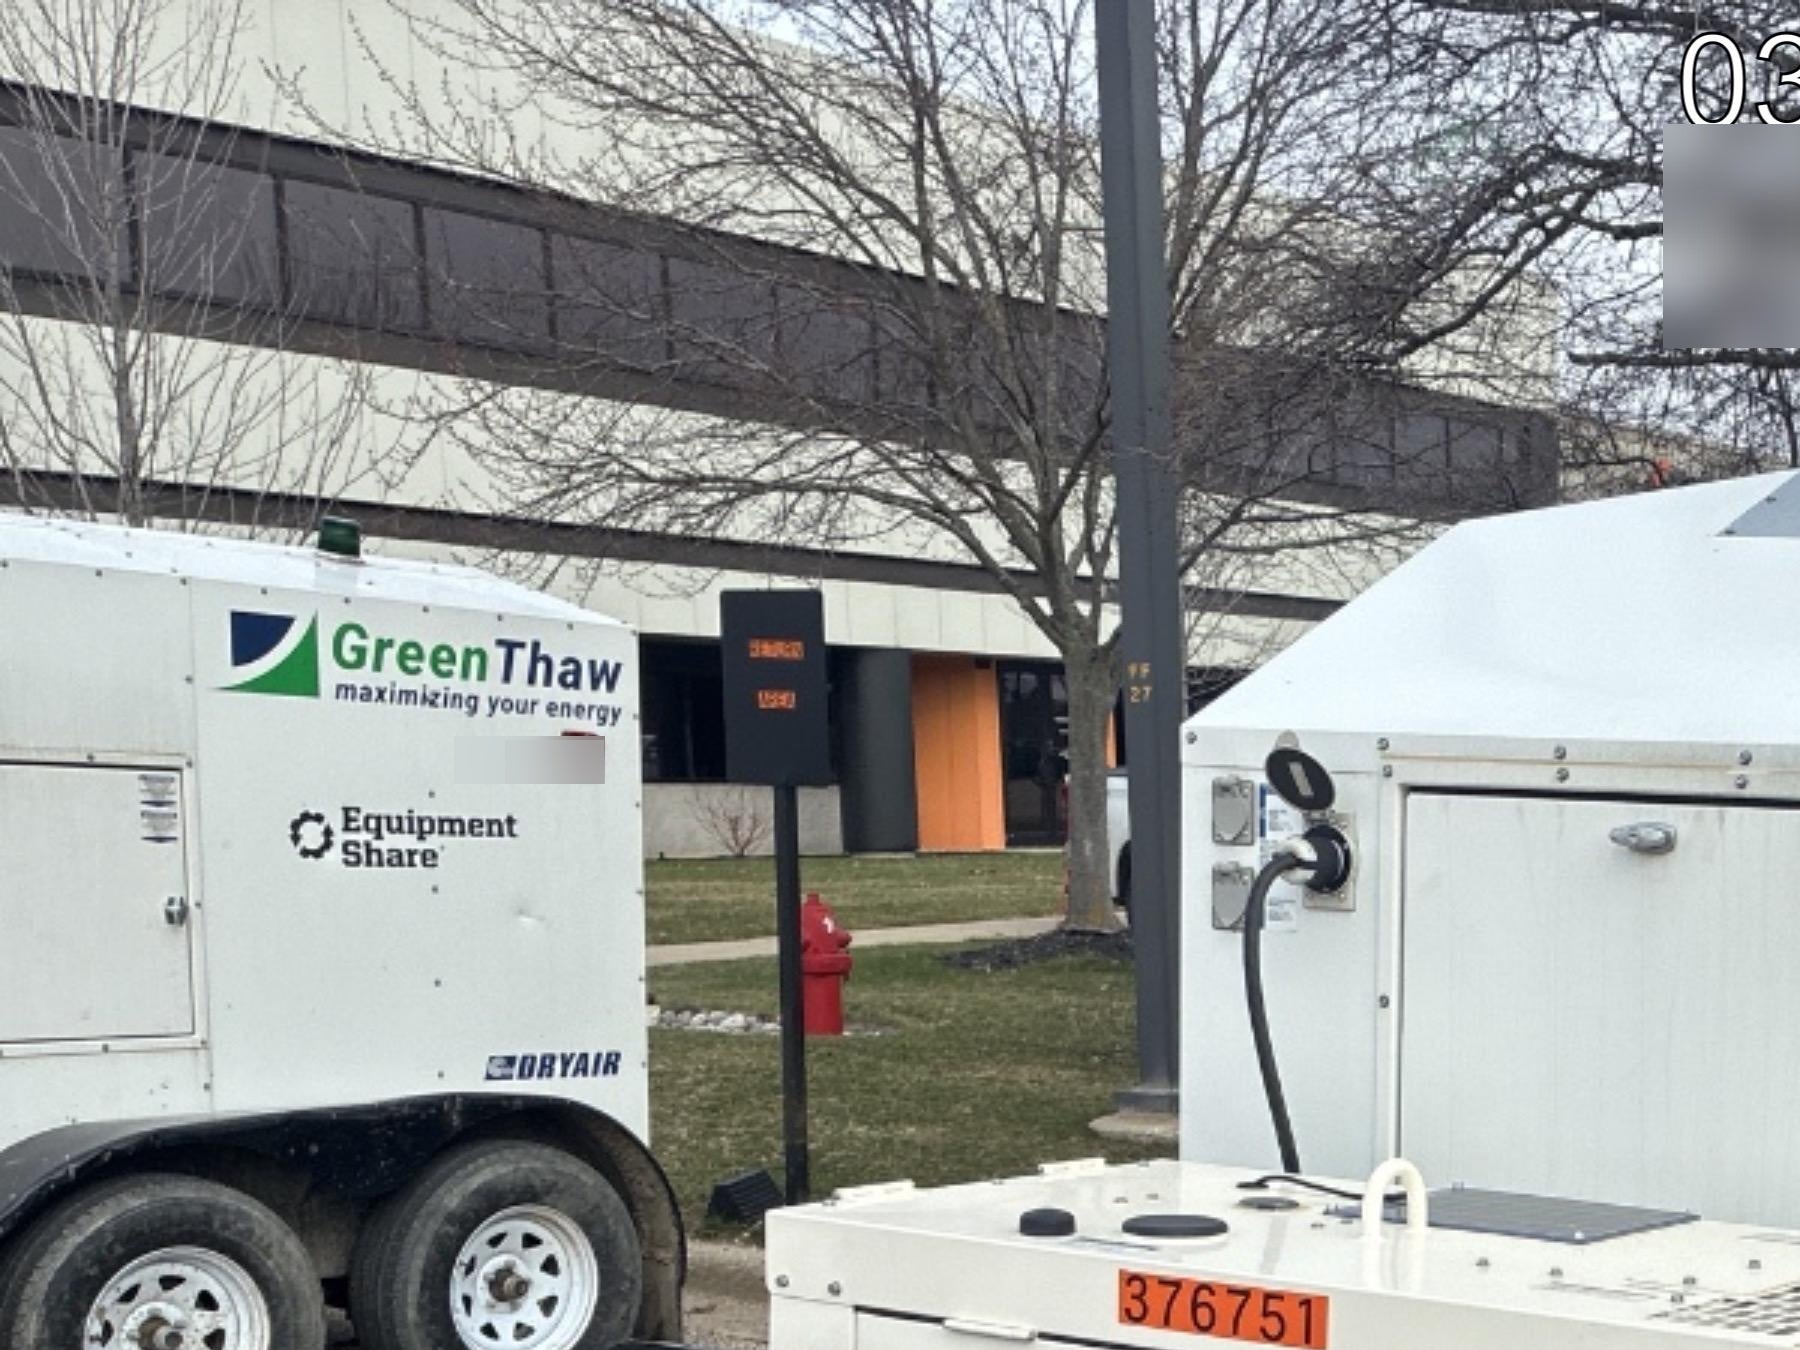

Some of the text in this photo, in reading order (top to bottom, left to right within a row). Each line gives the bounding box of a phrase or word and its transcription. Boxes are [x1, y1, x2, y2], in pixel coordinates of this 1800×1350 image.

[335, 680, 622, 726] maximizing your energy
[341, 806, 518, 840] Equipment
[341, 840, 439, 868] Share
[517, 1051, 622, 1080] DRYAIR
[1123, 1274, 1314, 1346] 376751
